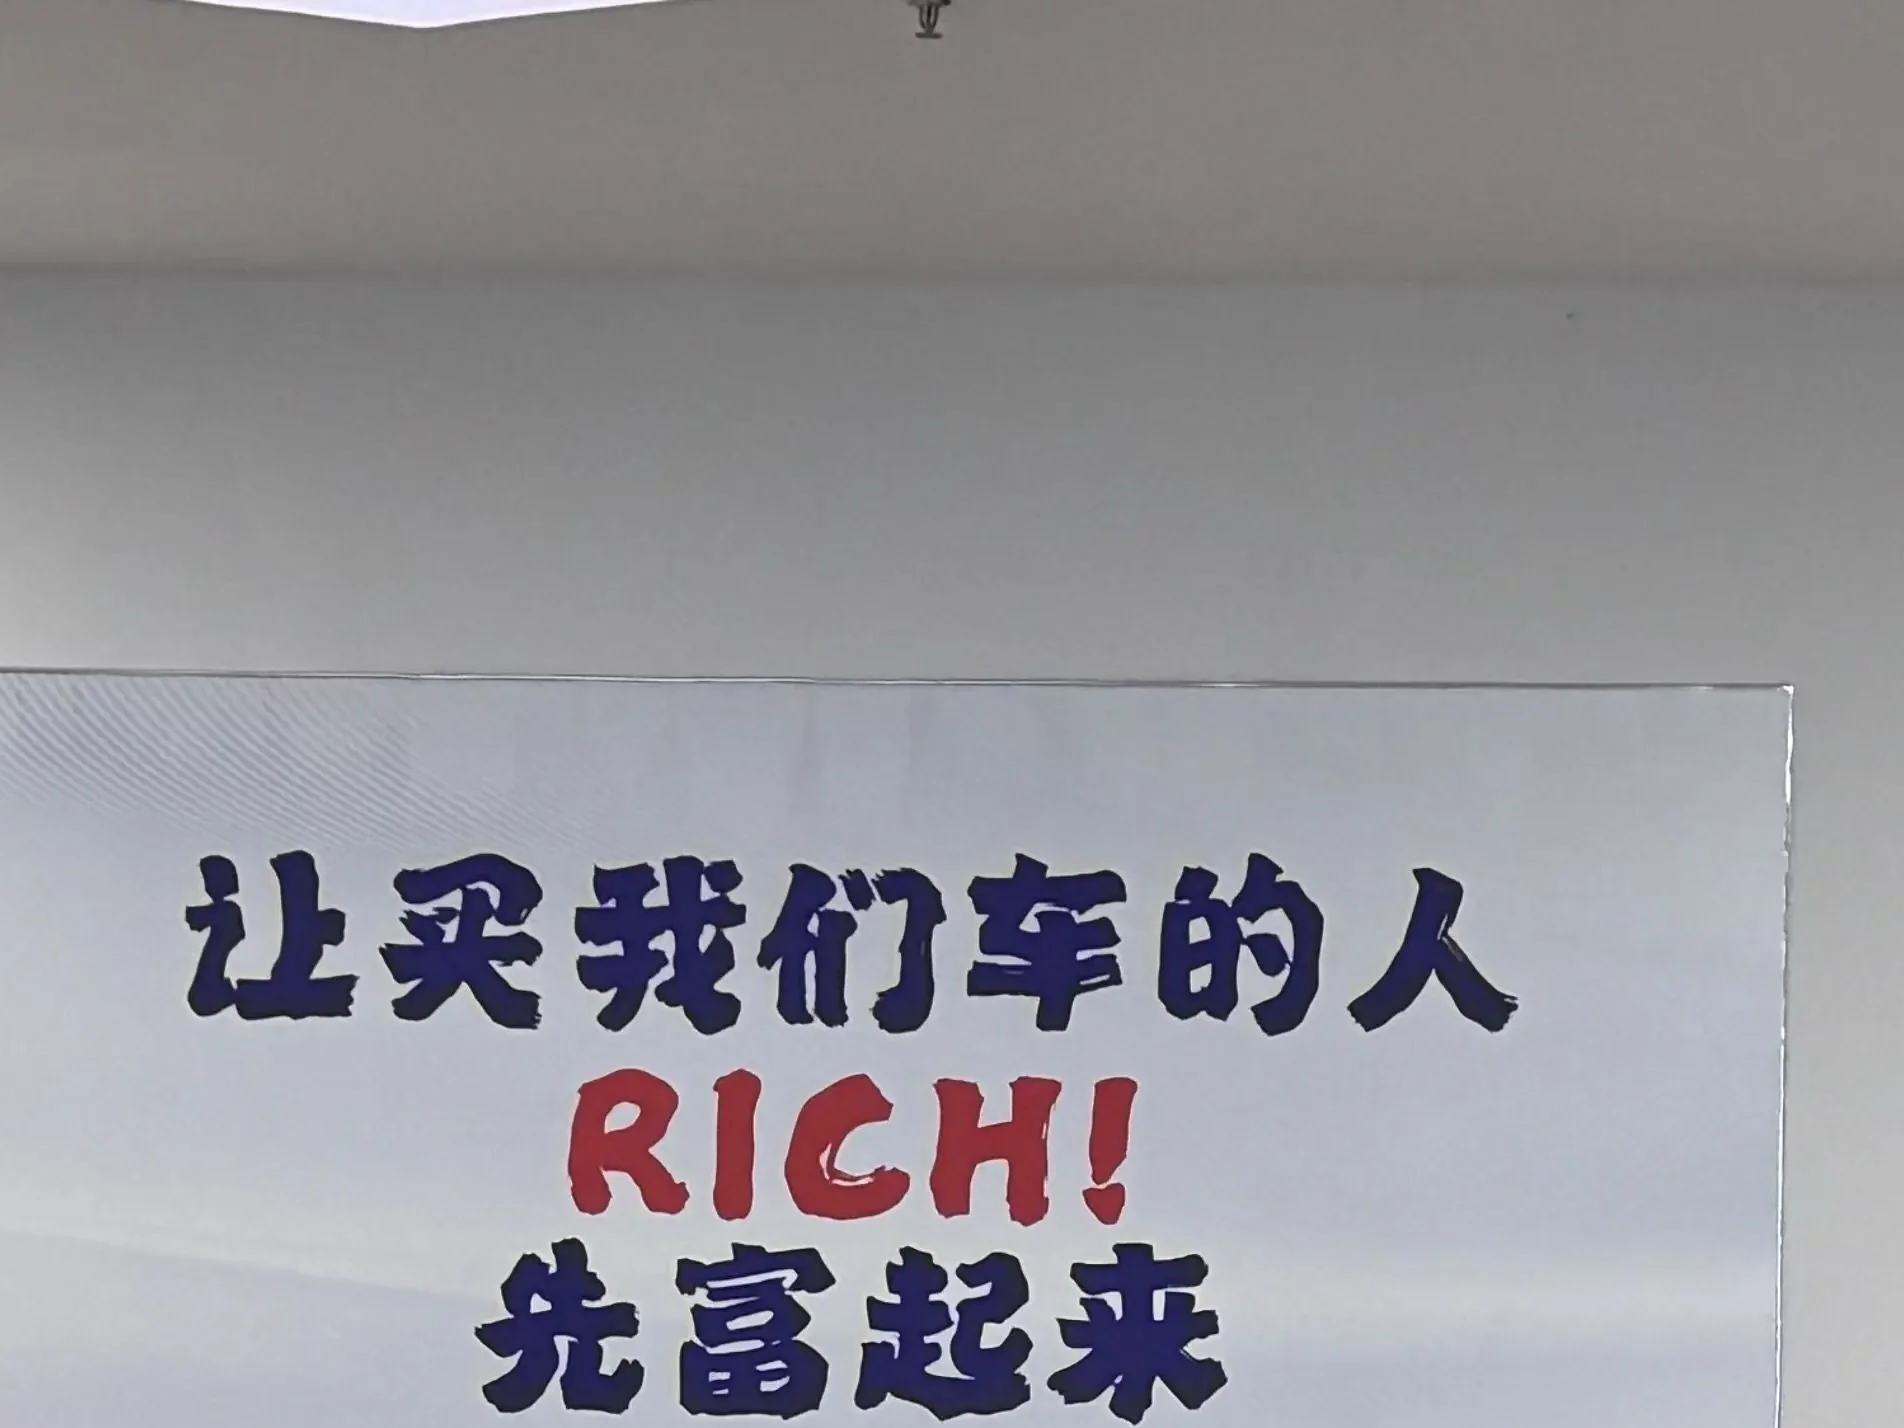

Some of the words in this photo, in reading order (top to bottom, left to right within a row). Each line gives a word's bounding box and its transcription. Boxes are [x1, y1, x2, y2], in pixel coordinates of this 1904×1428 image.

[184, 849, 1519, 1037] 让买我们车的人
[568, 1069, 1138, 1225] RICH!
[473, 1237, 1229, 1426] 先富起来
